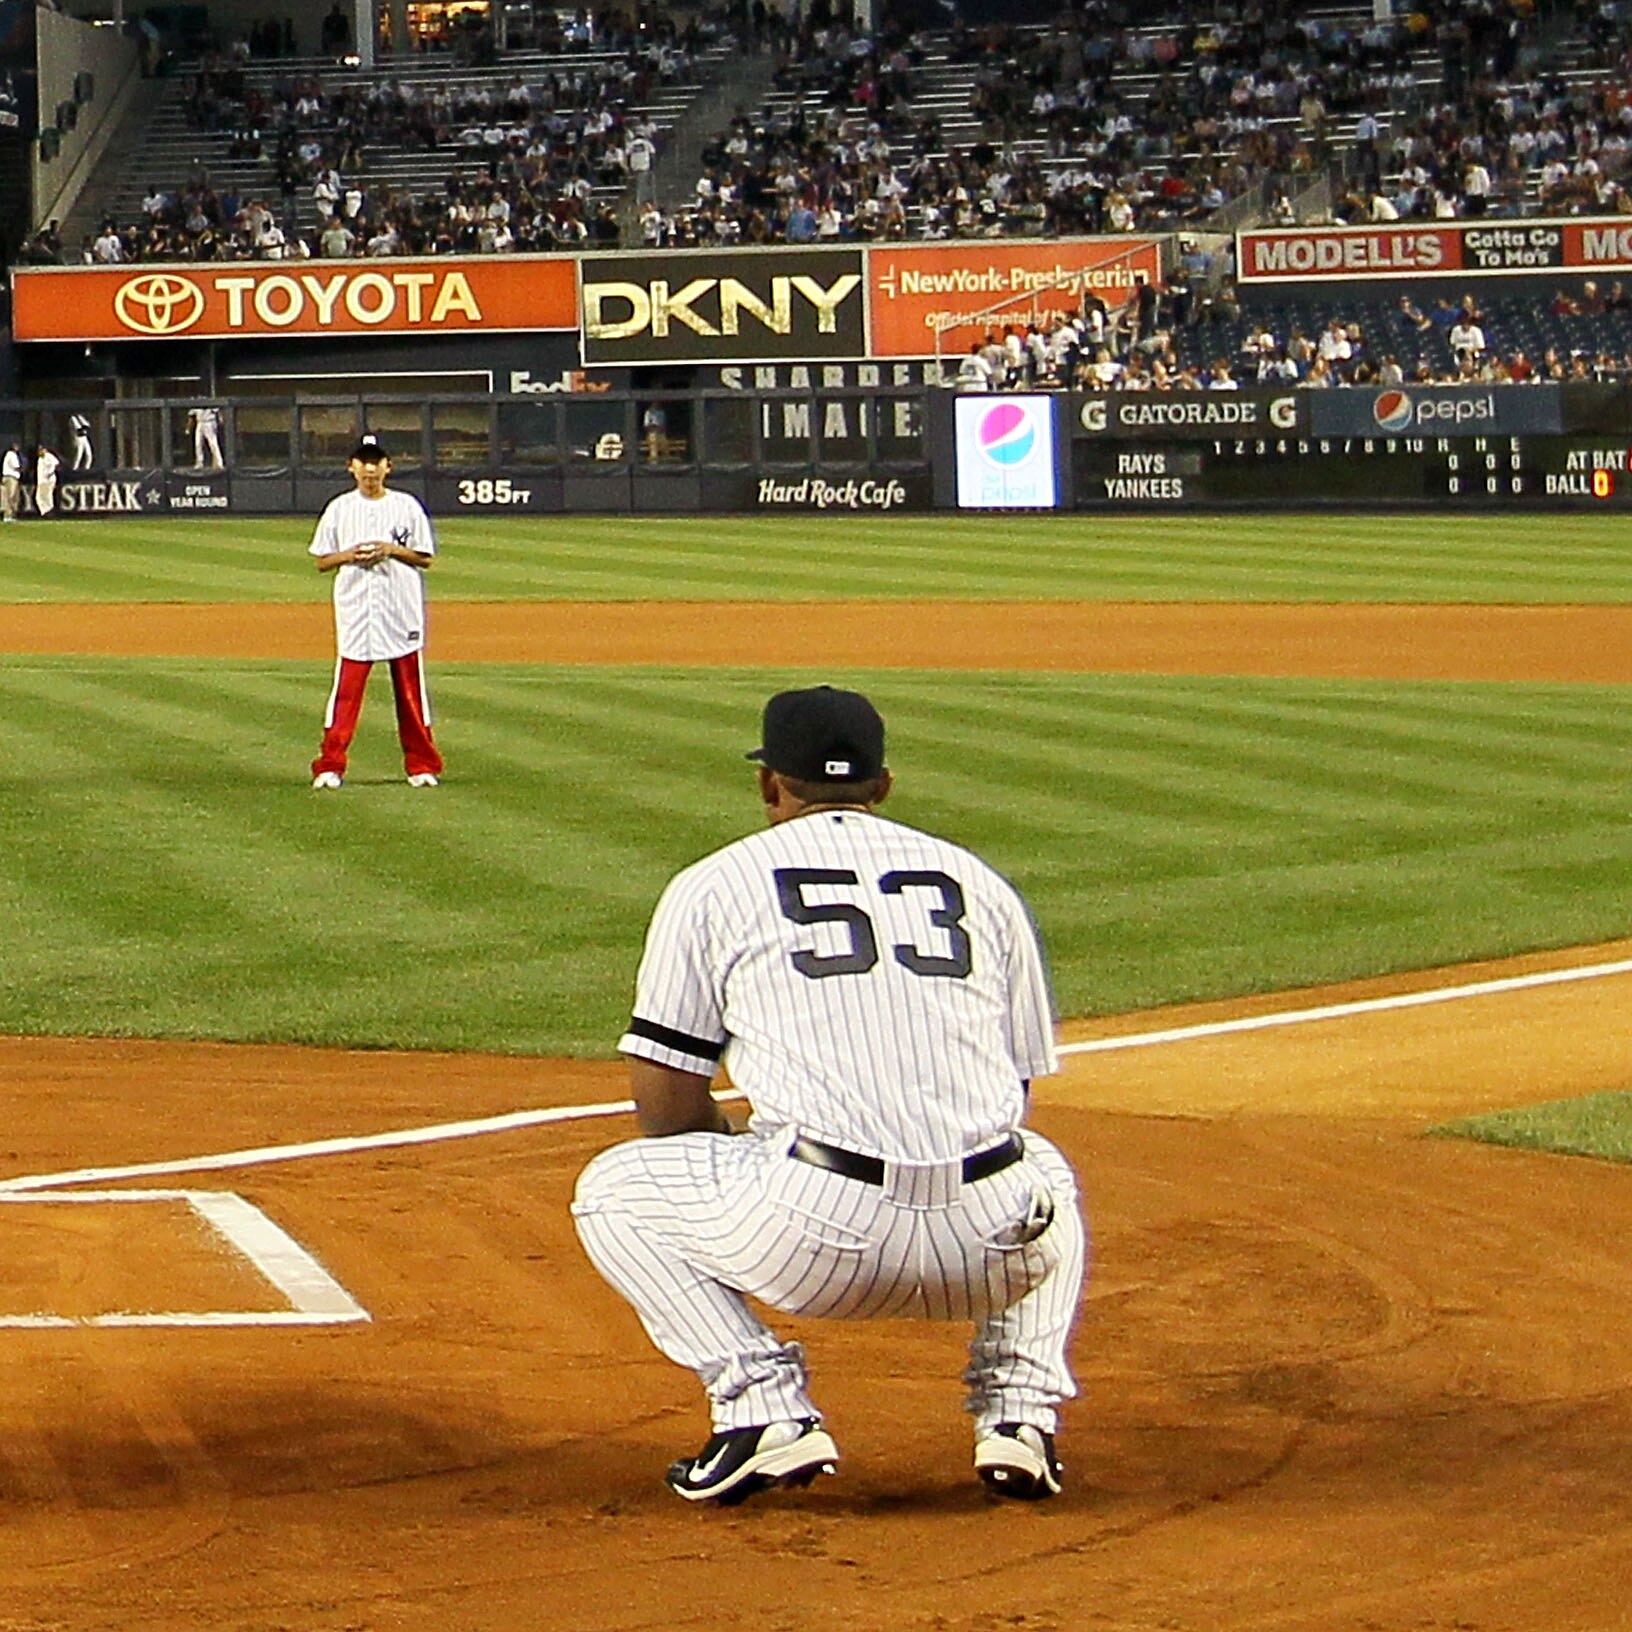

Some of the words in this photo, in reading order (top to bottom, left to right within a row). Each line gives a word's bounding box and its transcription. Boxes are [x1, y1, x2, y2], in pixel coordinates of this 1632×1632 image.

[1464, 230, 1526, 248] Gotta
[1529, 229, 1559, 246] Go
[1254, 235, 1445, 271] MODELL'S
[1476, 251, 1500, 266] To
[1505, 248, 1549, 266] Mo's
[215, 272, 483, 327] TOYOTA
[584, 274, 860, 341] DKNY
[1120, 403, 1256, 424] GATORADE
[1417, 395, 1495, 425] pepsi
[1214, 441, 1222, 455] 1
[1235, 441, 1245, 455] 2
[1256, 441, 1265, 455] 3
[1277, 441, 1286, 454] 4
[1511, 437, 1520, 451] E
[1119, 454, 1165, 474] RAYS
[1567, 451, 1587, 470] AT
[1593, 450, 1627, 469] BAT
[61, 482, 142, 511] STEAK
[185, 485, 211, 496] OPEN
[457, 479, 531, 505] 385FT
[758, 478, 807, 503] Hard
[810, 479, 857, 508] Rock
[859, 480, 905, 509] Cafe
[1105, 479, 1183, 499] YANKEES
[1546, 474, 1590, 494] BALL
[1593, 469, 1609, 497] 0
[170, 497, 194, 508] YEAR
[774, 867, 972, 980] 53
